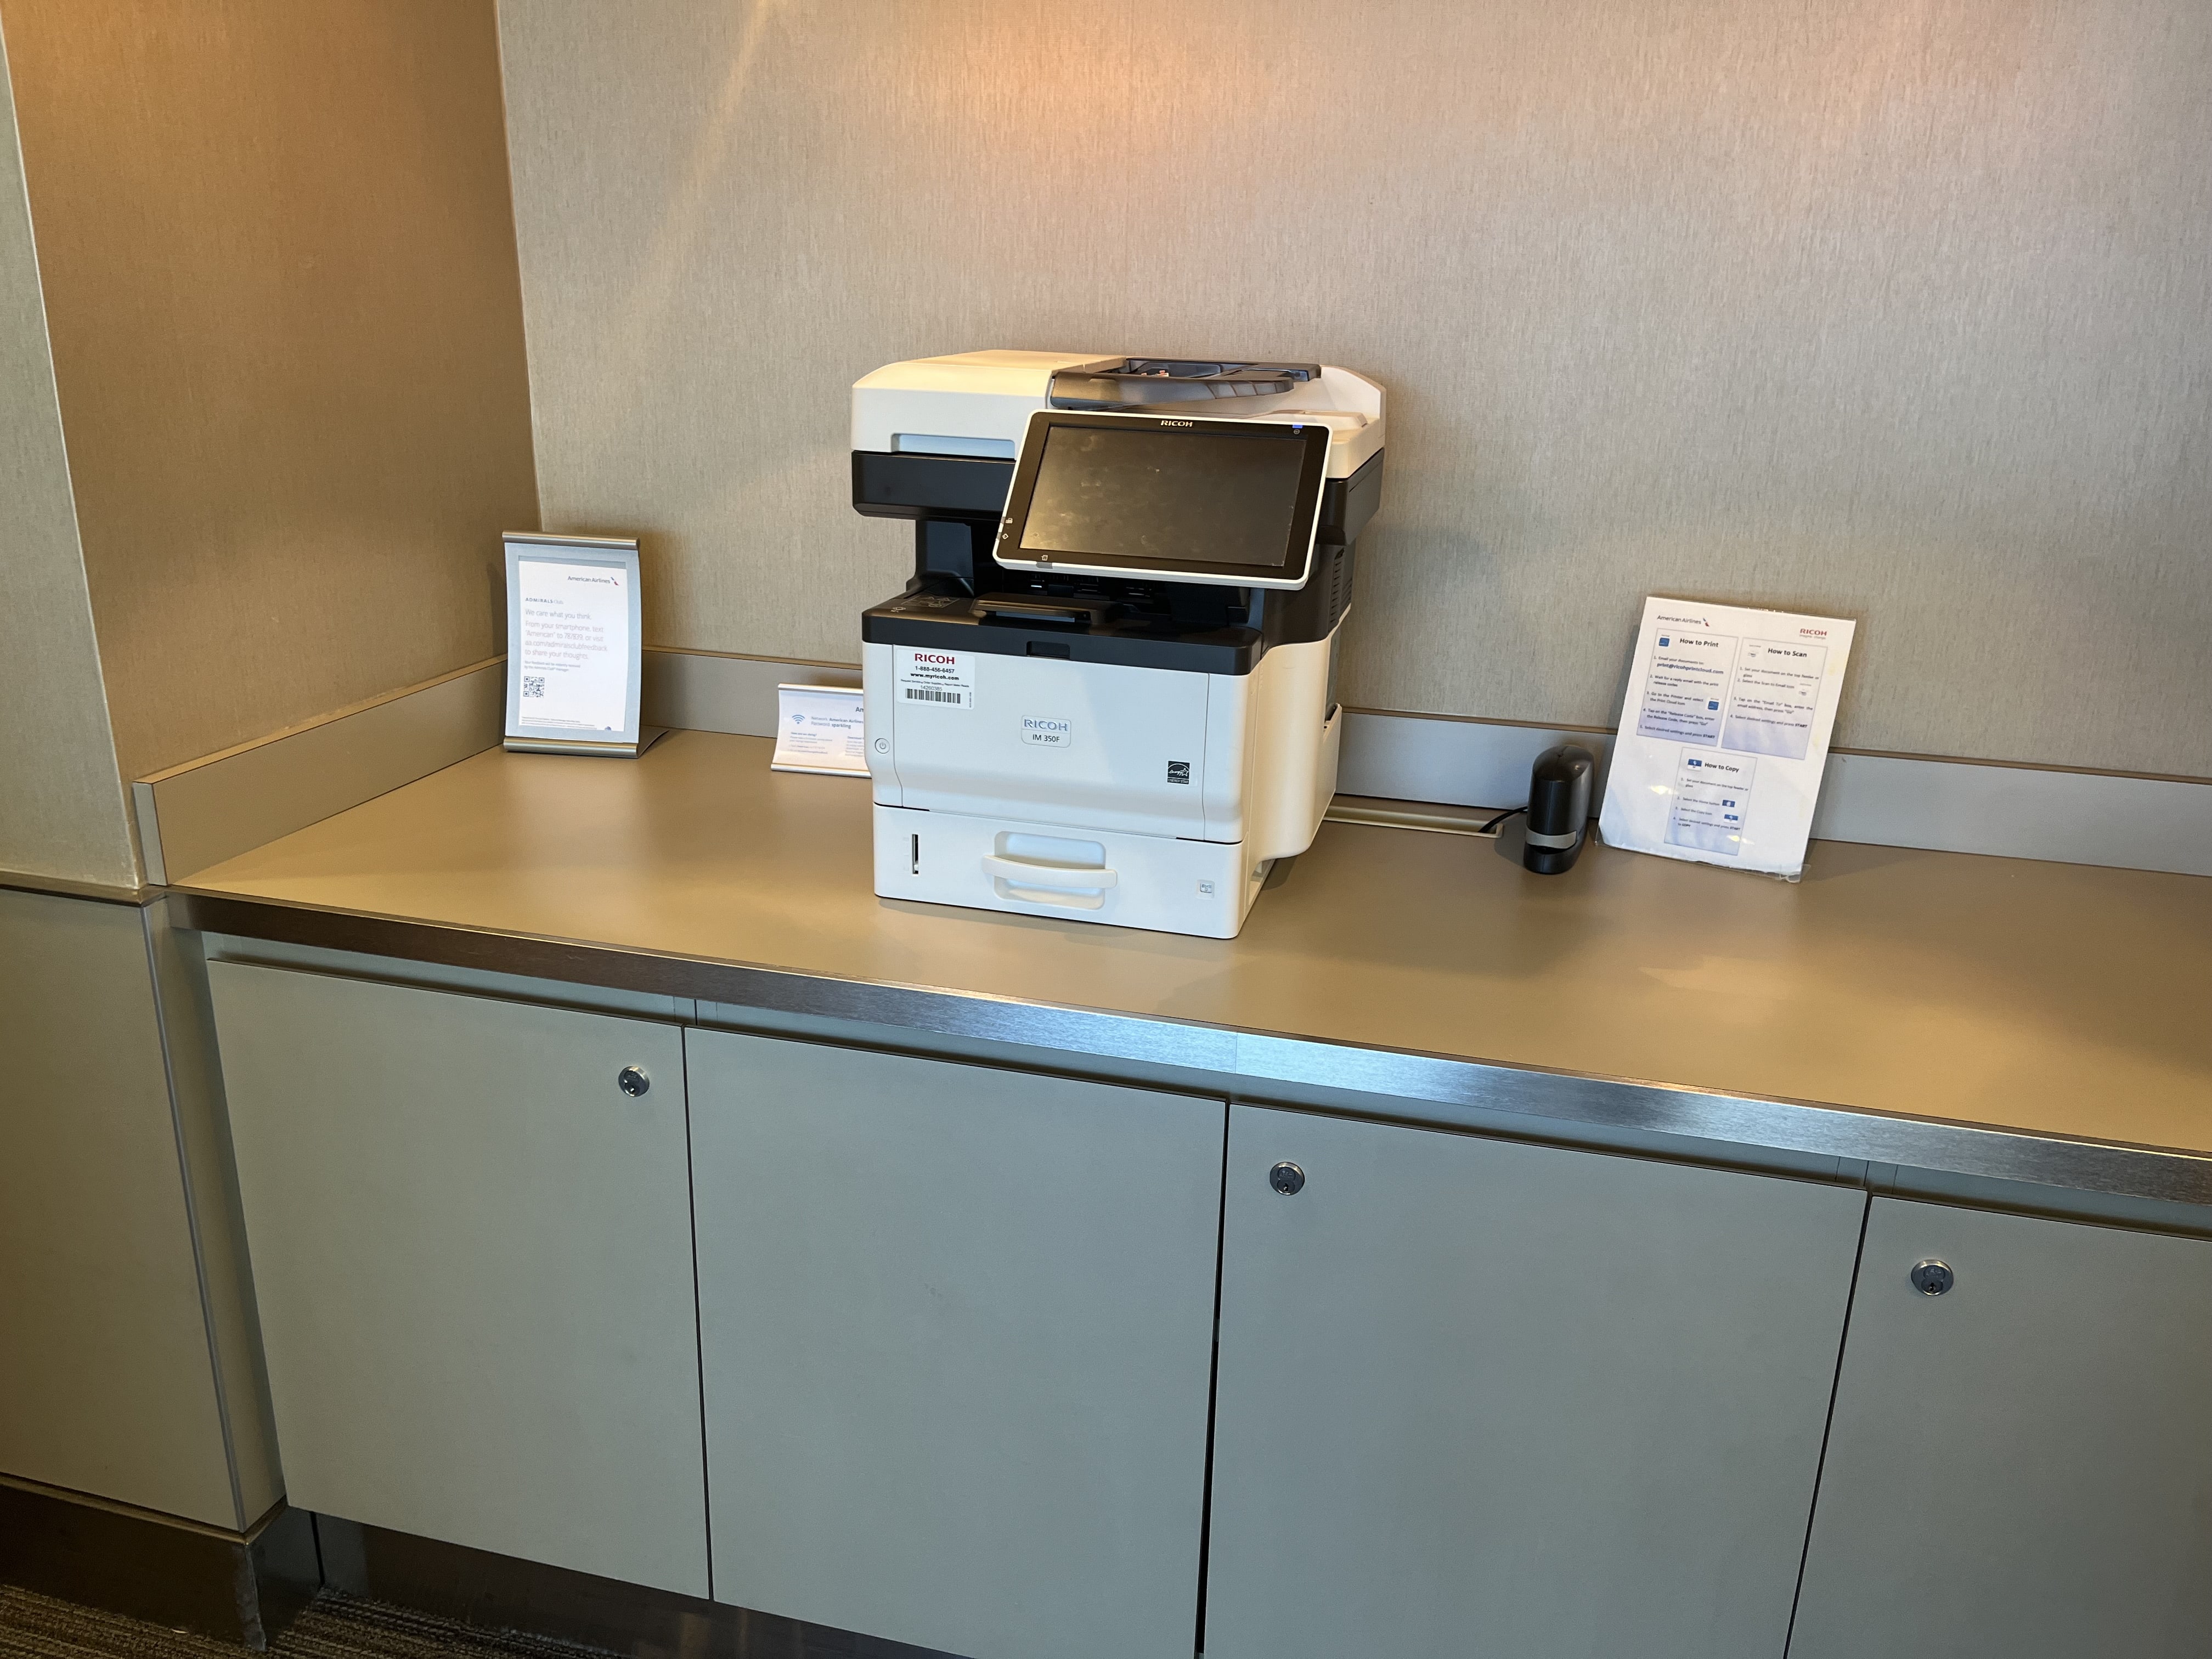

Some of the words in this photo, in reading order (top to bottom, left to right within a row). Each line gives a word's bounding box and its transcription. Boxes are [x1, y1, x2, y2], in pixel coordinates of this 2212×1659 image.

[915, 653, 955, 664] RICOH
[1657, 663, 1724, 674] print@ricohprintcloud.com
[1024, 719, 1068, 731] RICOH
